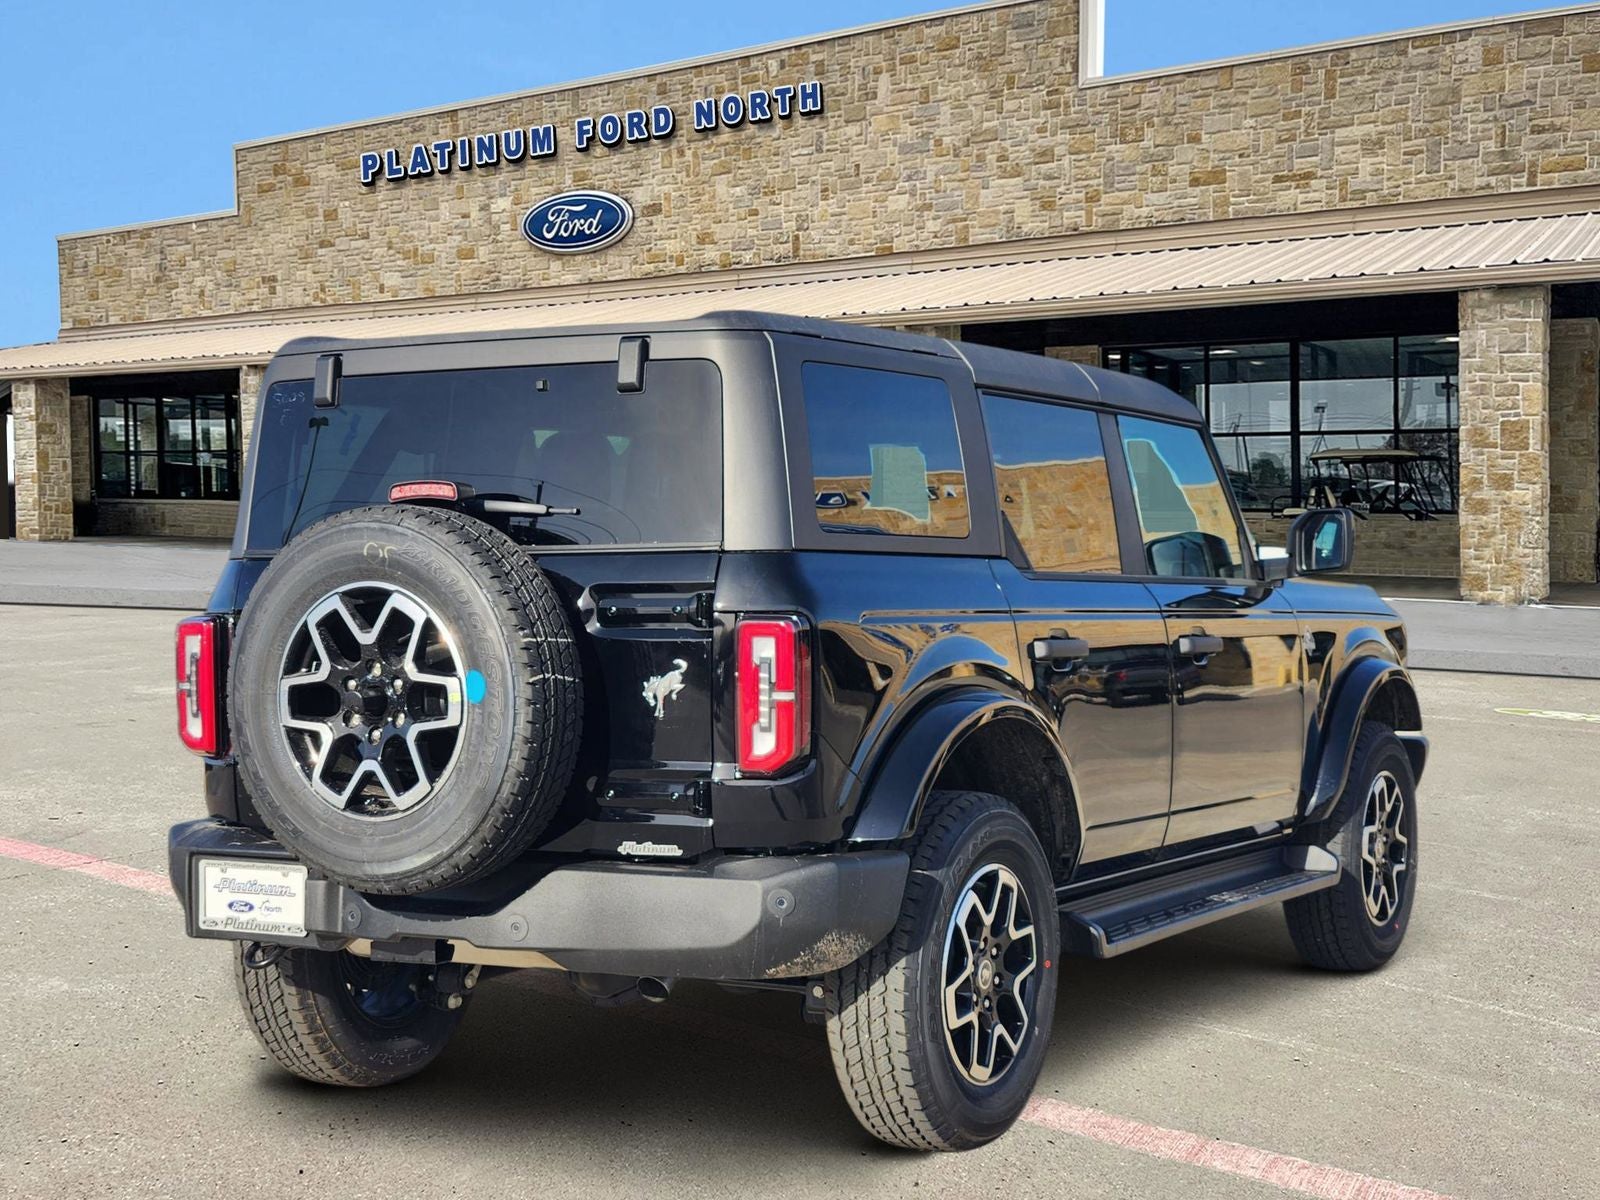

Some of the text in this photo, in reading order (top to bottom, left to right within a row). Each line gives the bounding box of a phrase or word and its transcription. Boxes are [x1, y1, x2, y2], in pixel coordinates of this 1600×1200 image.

[360, 81, 823, 185] PLATINUM FORD NORTH
[541, 205, 602, 239] Ford
[213, 877, 296, 897] Platinum
[224, 917, 281, 932] Platinum
